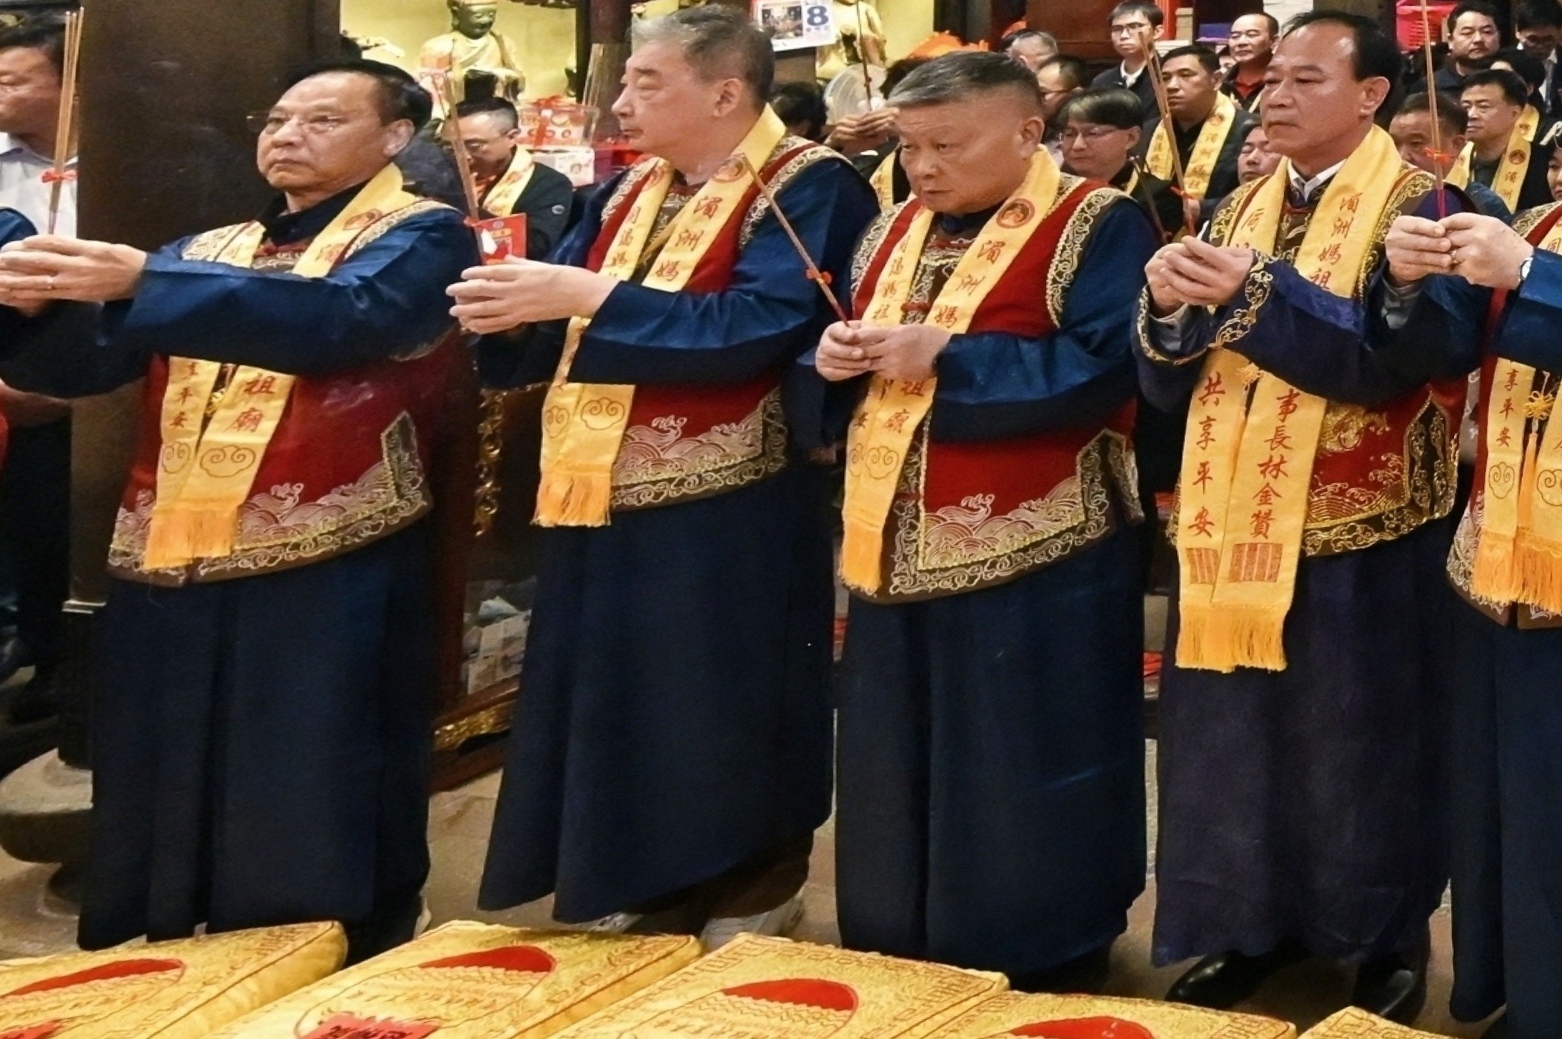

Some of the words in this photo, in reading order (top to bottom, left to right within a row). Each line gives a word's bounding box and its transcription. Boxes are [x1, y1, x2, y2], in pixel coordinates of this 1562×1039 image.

[806, 5, 829, 26] 8
[934, 240, 1007, 329] 湄洲媽
[1309, 191, 1363, 291] 湄洲媽祖
[1497, 368, 1522, 448] 享平安
[1188, 371, 1226, 539] 共享平安
